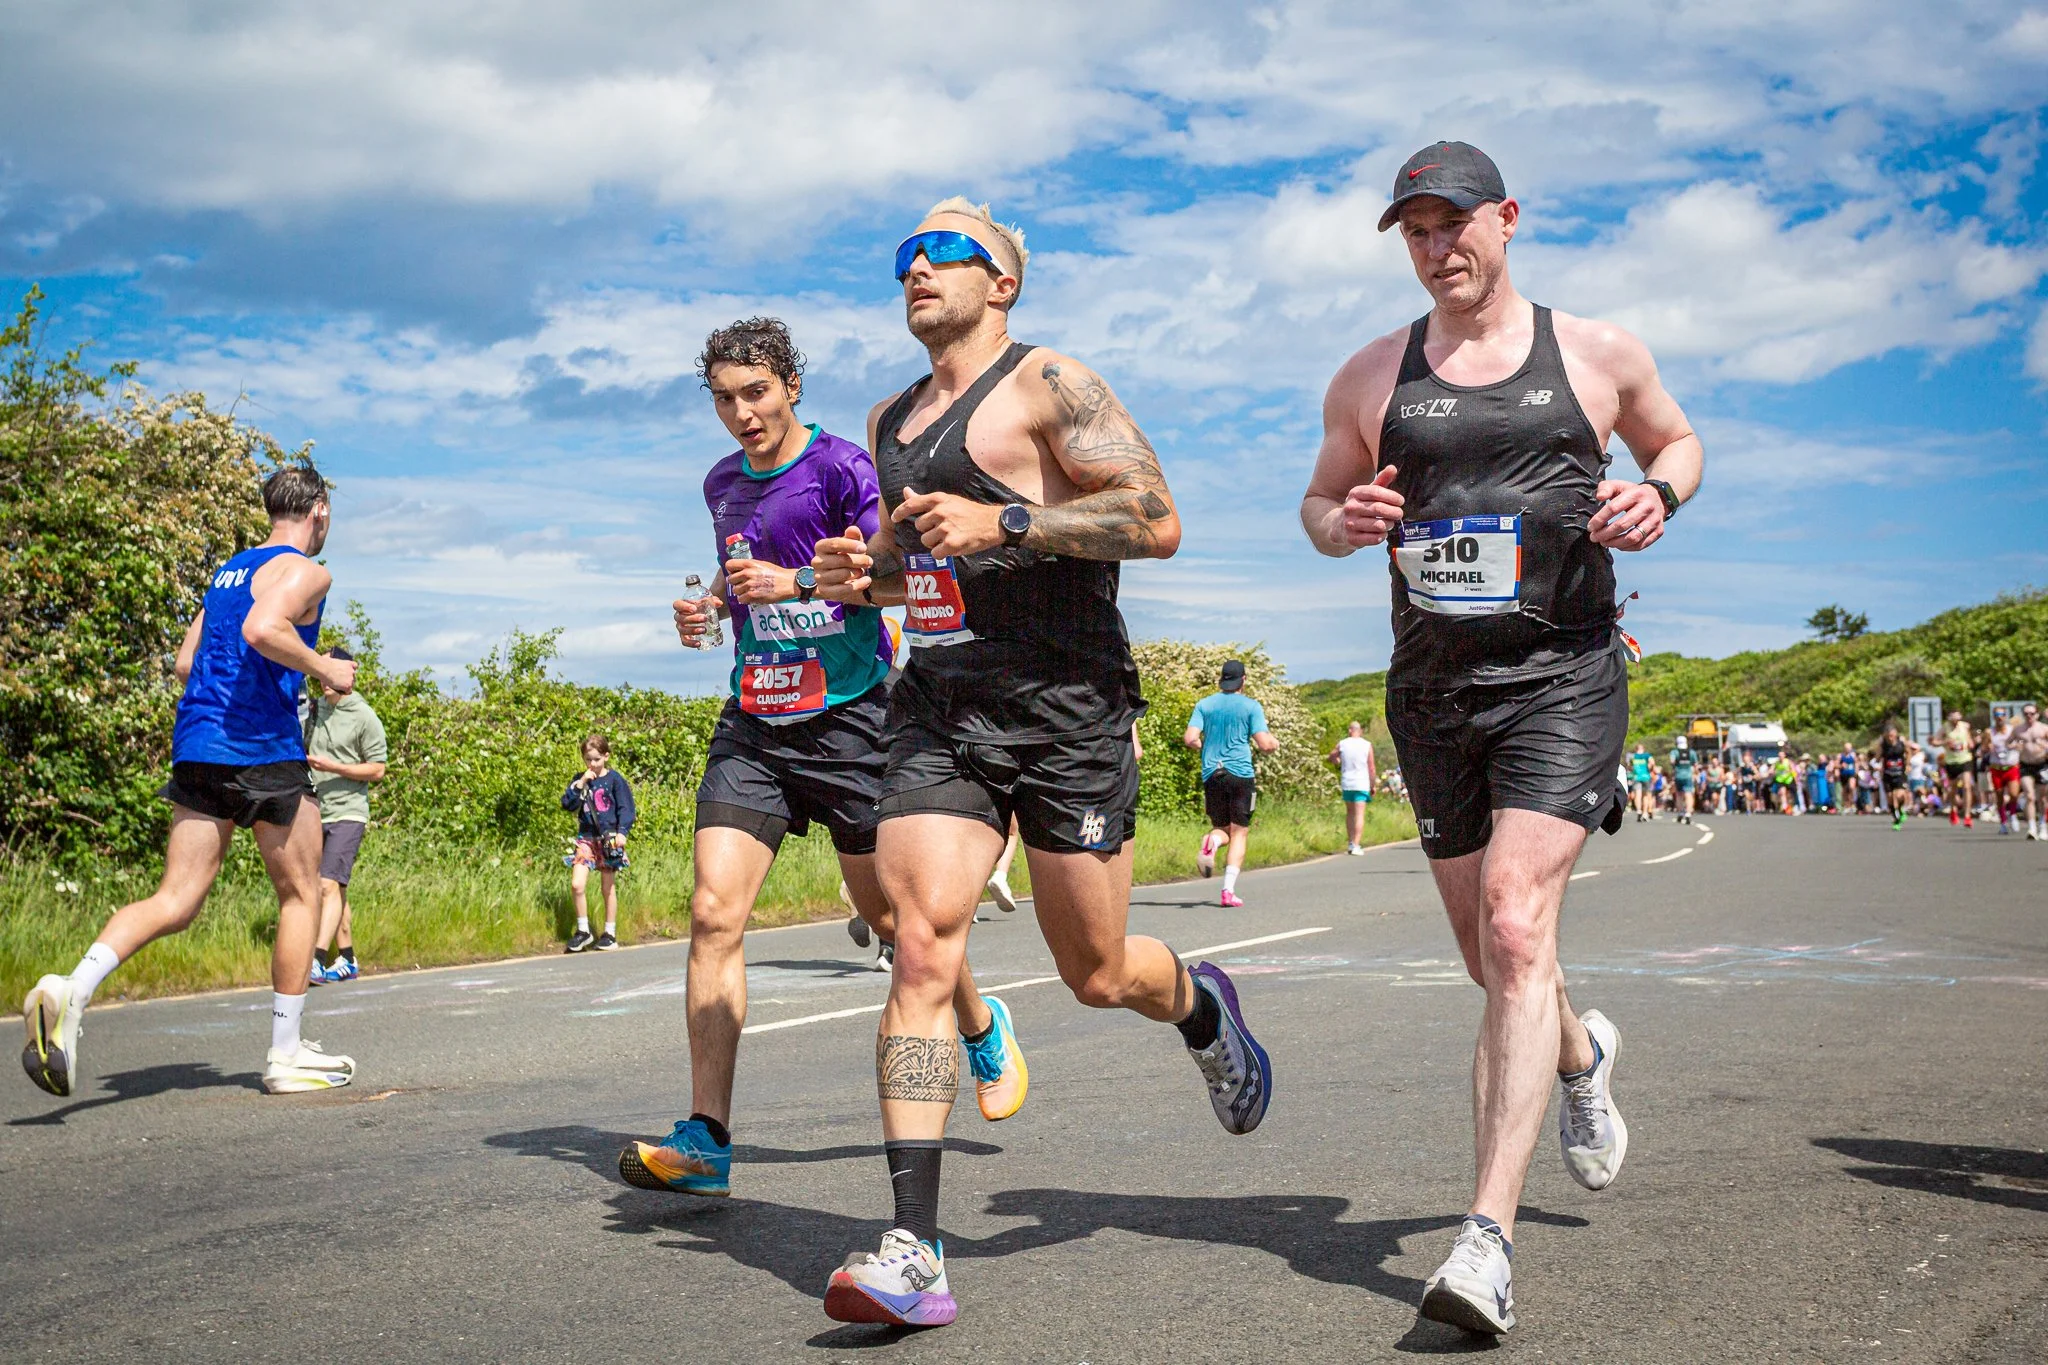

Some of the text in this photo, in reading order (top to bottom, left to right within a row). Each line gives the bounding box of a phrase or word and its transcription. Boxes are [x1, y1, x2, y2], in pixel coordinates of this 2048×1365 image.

[1422, 536, 1480, 564] 510
[1420, 569, 1486, 584] MICHAEL
[1468, 604, 1495, 612] JustGiving
[757, 608, 827, 633] action
[752, 664, 804, 690] 2057
[756, 691, 801, 706] CLAUDIO
